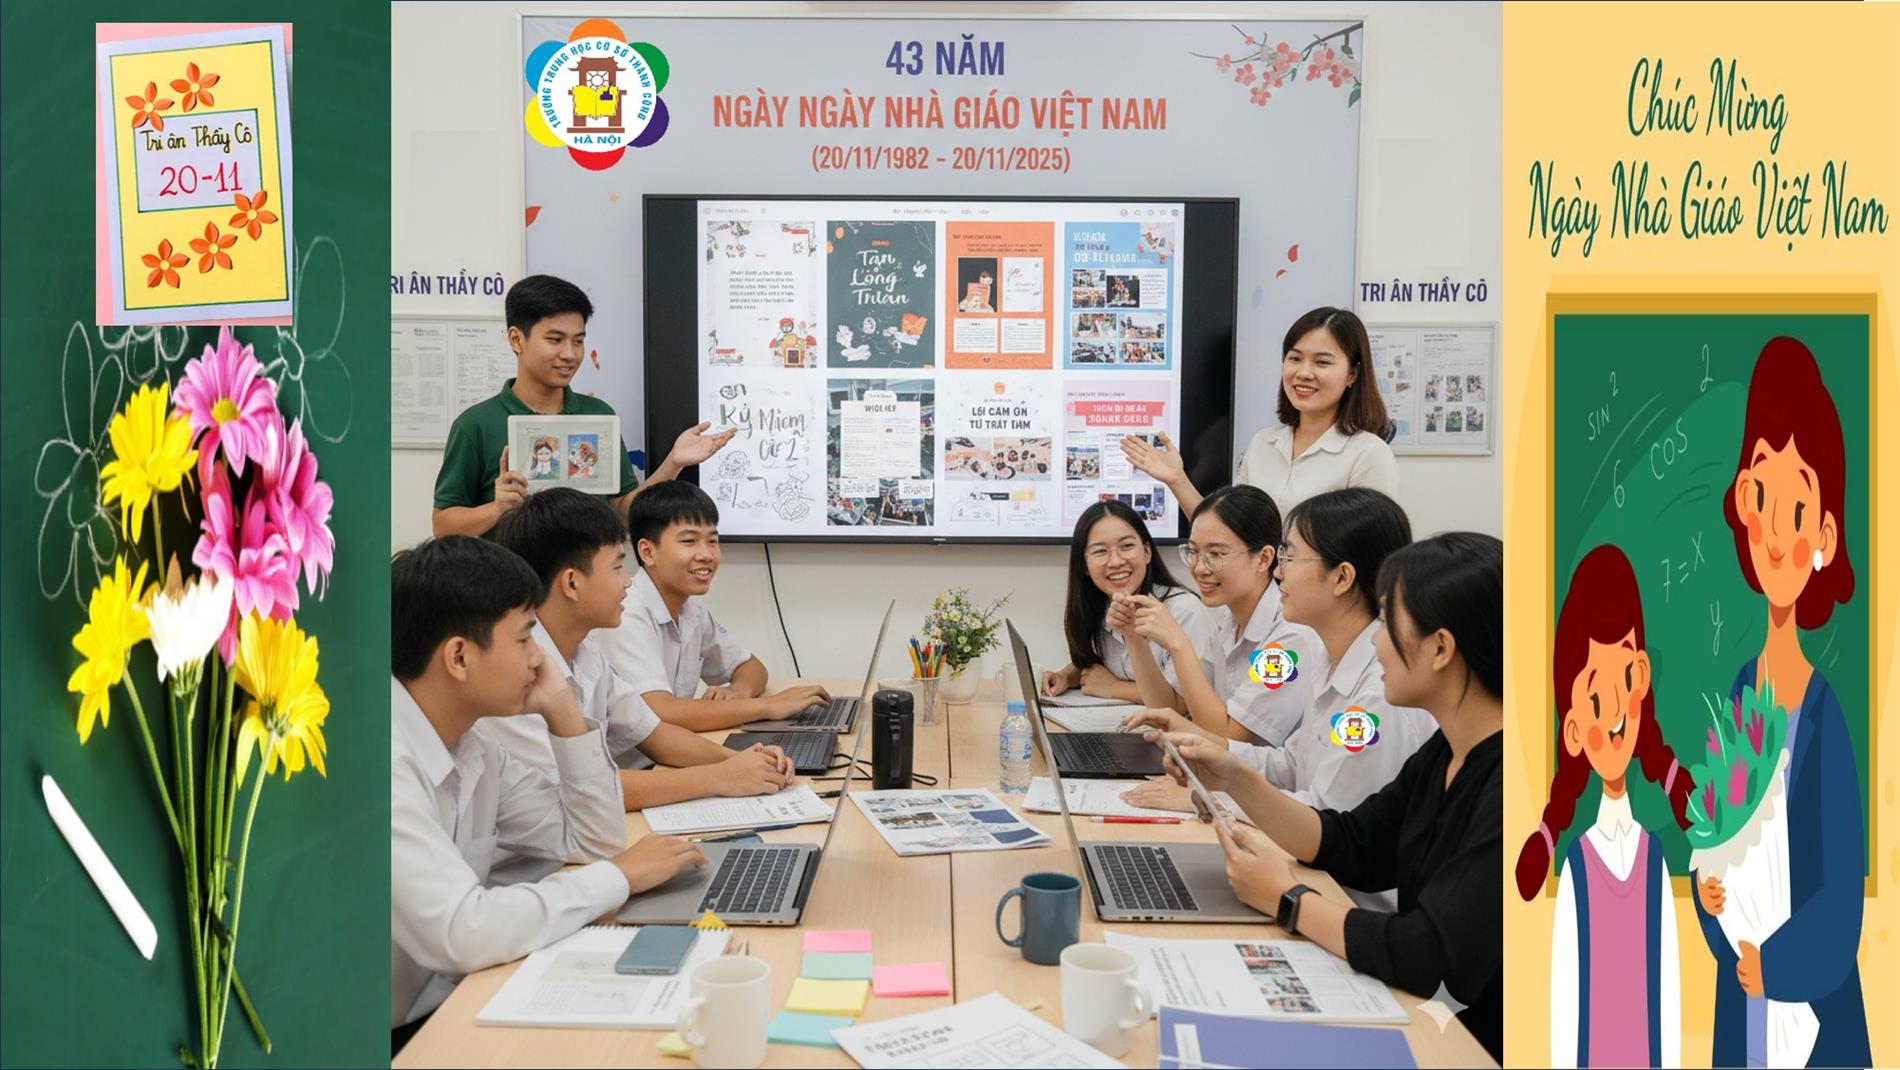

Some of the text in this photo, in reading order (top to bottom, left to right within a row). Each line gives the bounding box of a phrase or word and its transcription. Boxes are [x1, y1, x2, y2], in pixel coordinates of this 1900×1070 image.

[886, 33, 1005, 76] 43 NĂM
[713, 87, 1167, 137] NGÀY NGÀY NHÀ GIÁO VIỆT NAM
[1628, 57, 1788, 155] Chúc Mừng
[140, 122, 253, 153] Tri ân Thầy Cô
[812, 144, 929, 173] (20/11/1982
[952, 146, 1071, 175] 20/11/2025)
[159, 161, 243, 197] 20-11
[1529, 160, 1889, 258] Ngày Nhà Giáo Việt Nam
[409, 271, 431, 295] ÂN
[436, 268, 478, 295] THẦY
[483, 272, 504, 296] CÔ
[1360, 276, 1488, 302] TRI ÂN THẦY CÔ
[1609, 370, 1619, 397] 2
[1700, 344, 1714, 393] 2
[1588, 403, 1610, 441] SIN
[1613, 459, 1625, 508] 6
